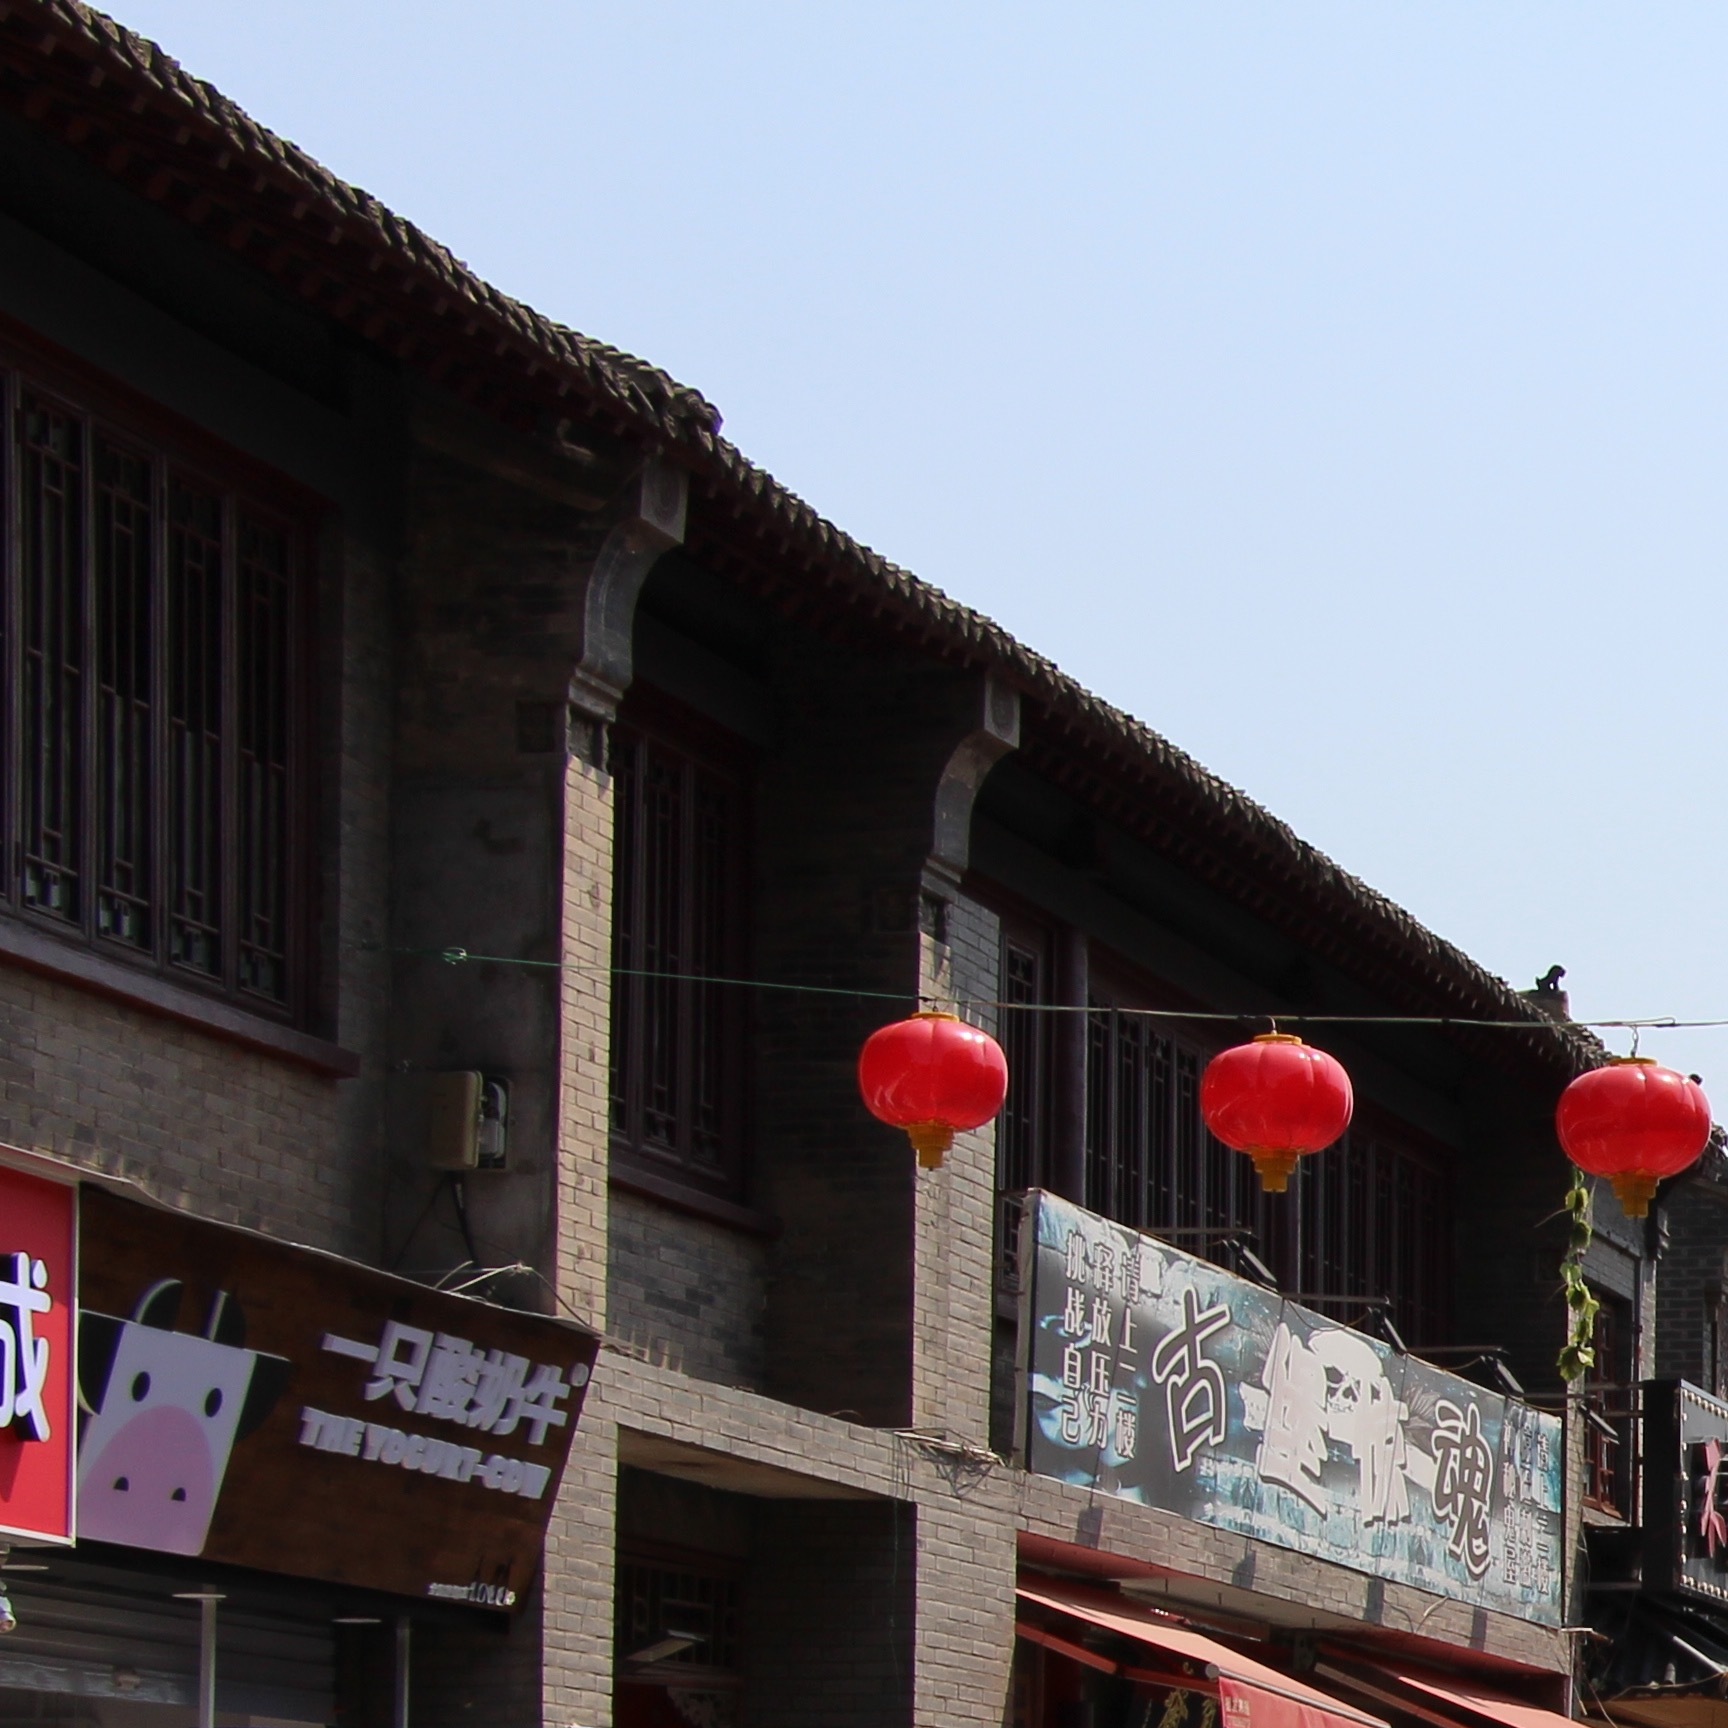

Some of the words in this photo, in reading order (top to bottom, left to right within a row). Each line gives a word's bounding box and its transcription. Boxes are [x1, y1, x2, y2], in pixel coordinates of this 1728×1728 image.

[300, 1406, 362, 1457] THE
[321, 1319, 570, 1445] 一只酸奶牛
[1062, 1230, 1087, 1444] 挑战自己
[1089, 1238, 1115, 1450] 释放压力
[1116, 1240, 1141, 1459] 请上二楼
